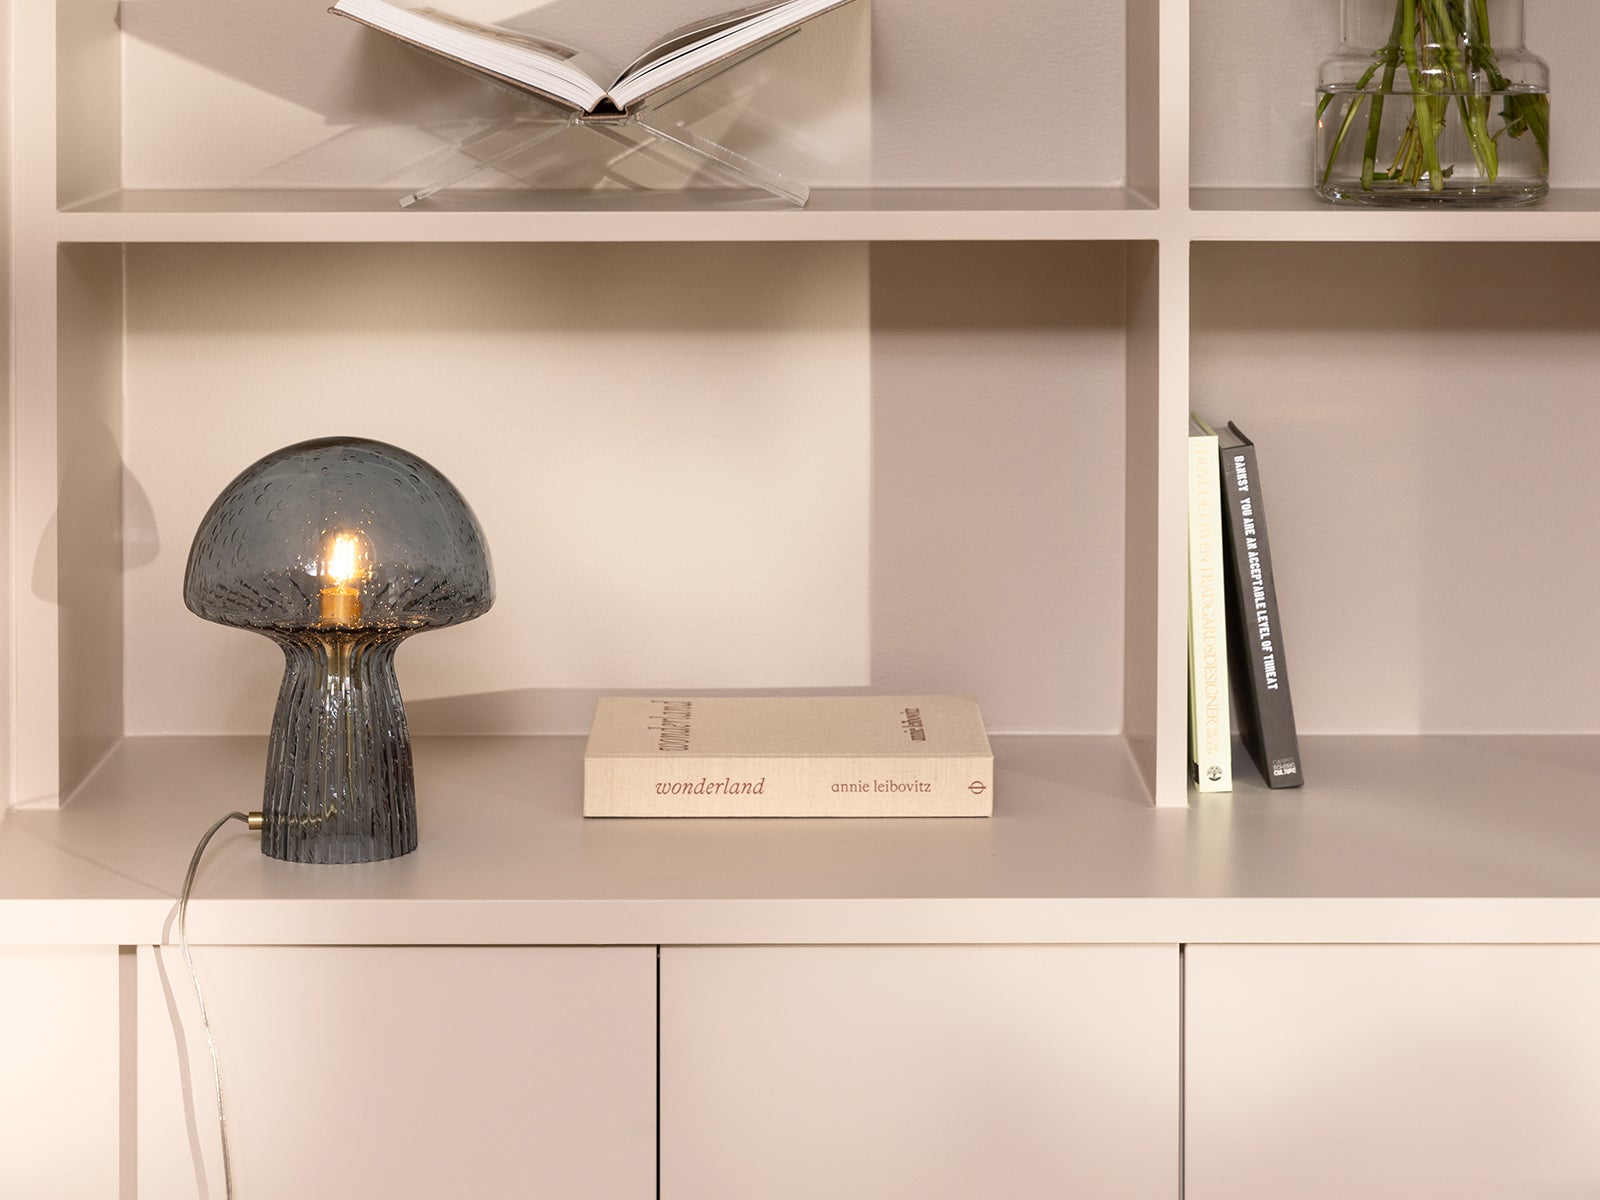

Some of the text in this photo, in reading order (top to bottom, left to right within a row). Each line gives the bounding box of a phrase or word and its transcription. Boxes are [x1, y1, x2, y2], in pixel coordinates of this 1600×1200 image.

[1234, 455, 1278, 690] BANKSY YOU ARE AN ACCEPTABLE LEVEL OF THREAT
[648, 700, 691, 751] wonderland
[655, 777, 931, 795] wonderland annie leibovitz
